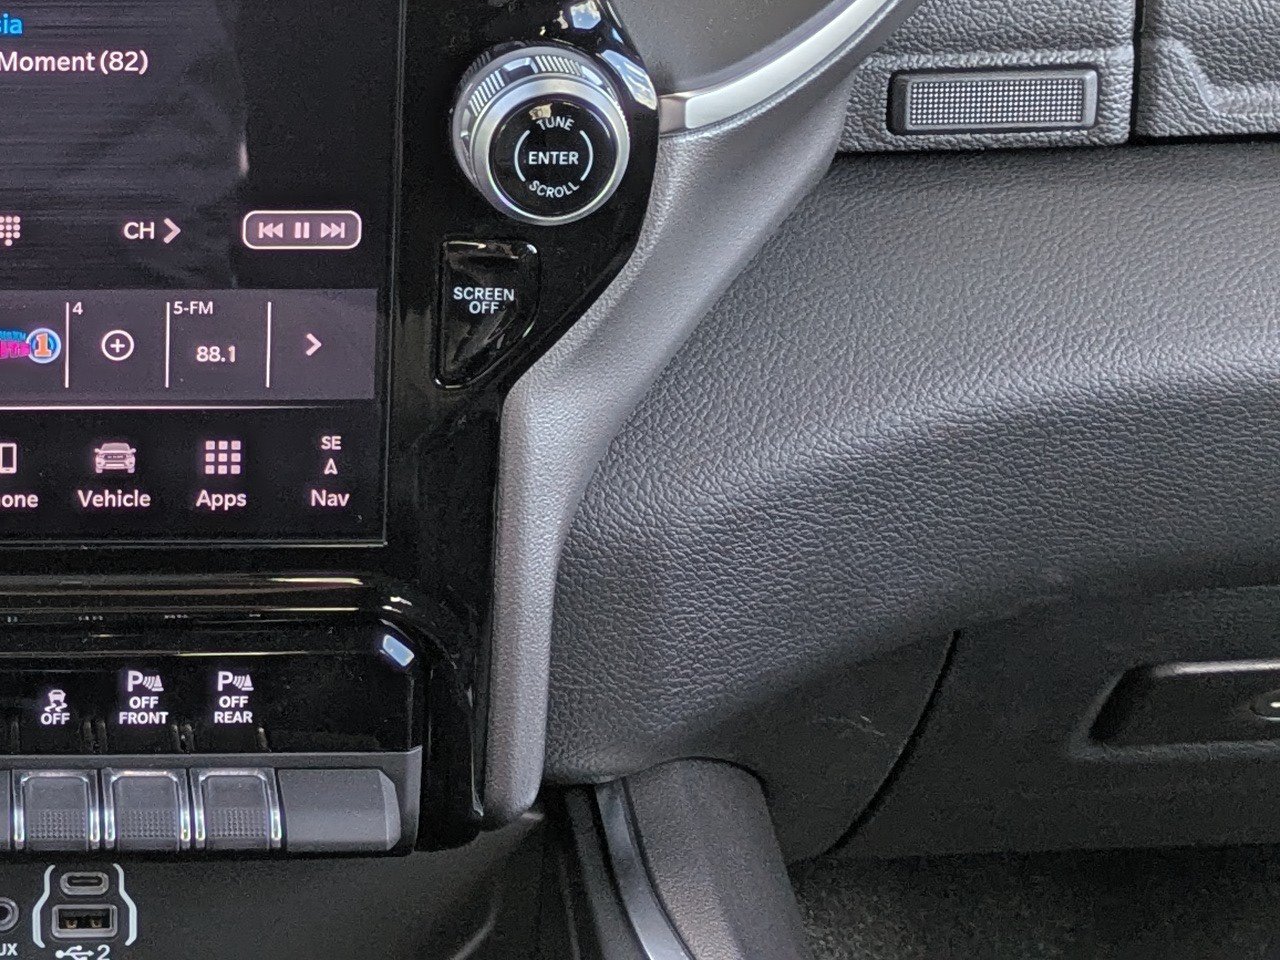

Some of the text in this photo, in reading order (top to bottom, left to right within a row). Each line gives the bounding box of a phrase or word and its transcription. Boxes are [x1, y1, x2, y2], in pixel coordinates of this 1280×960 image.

[99, 49, 149, 76] (82)
[536, 116, 575, 132] TUNE
[528, 151, 579, 165] ENTER
[528, 180, 580, 198] SCROLL
[123, 222, 156, 240] CH
[453, 286, 515, 302] SCREEN
[72, 301, 84, 316] 4
[173, 301, 214, 316] 5-FM
[468, 301, 500, 314] OFF
[34, 332, 52, 358] 1
[196, 345, 236, 363] 88.1
[320, 436, 342, 451] SE
[77, 489, 152, 508] Vehicle
[195, 489, 247, 511] Apps
[310, 489, 350, 508] Nav
[127, 670, 144, 692] P
[217, 670, 233, 692] P
[129, 695, 159, 709] OFF
[218, 695, 249, 709] OFF
[40, 712, 70, 725] OFF
[119, 711, 169, 725] FRONT
[214, 711, 253, 724] REAR
[96, 944, 110, 960] 2
